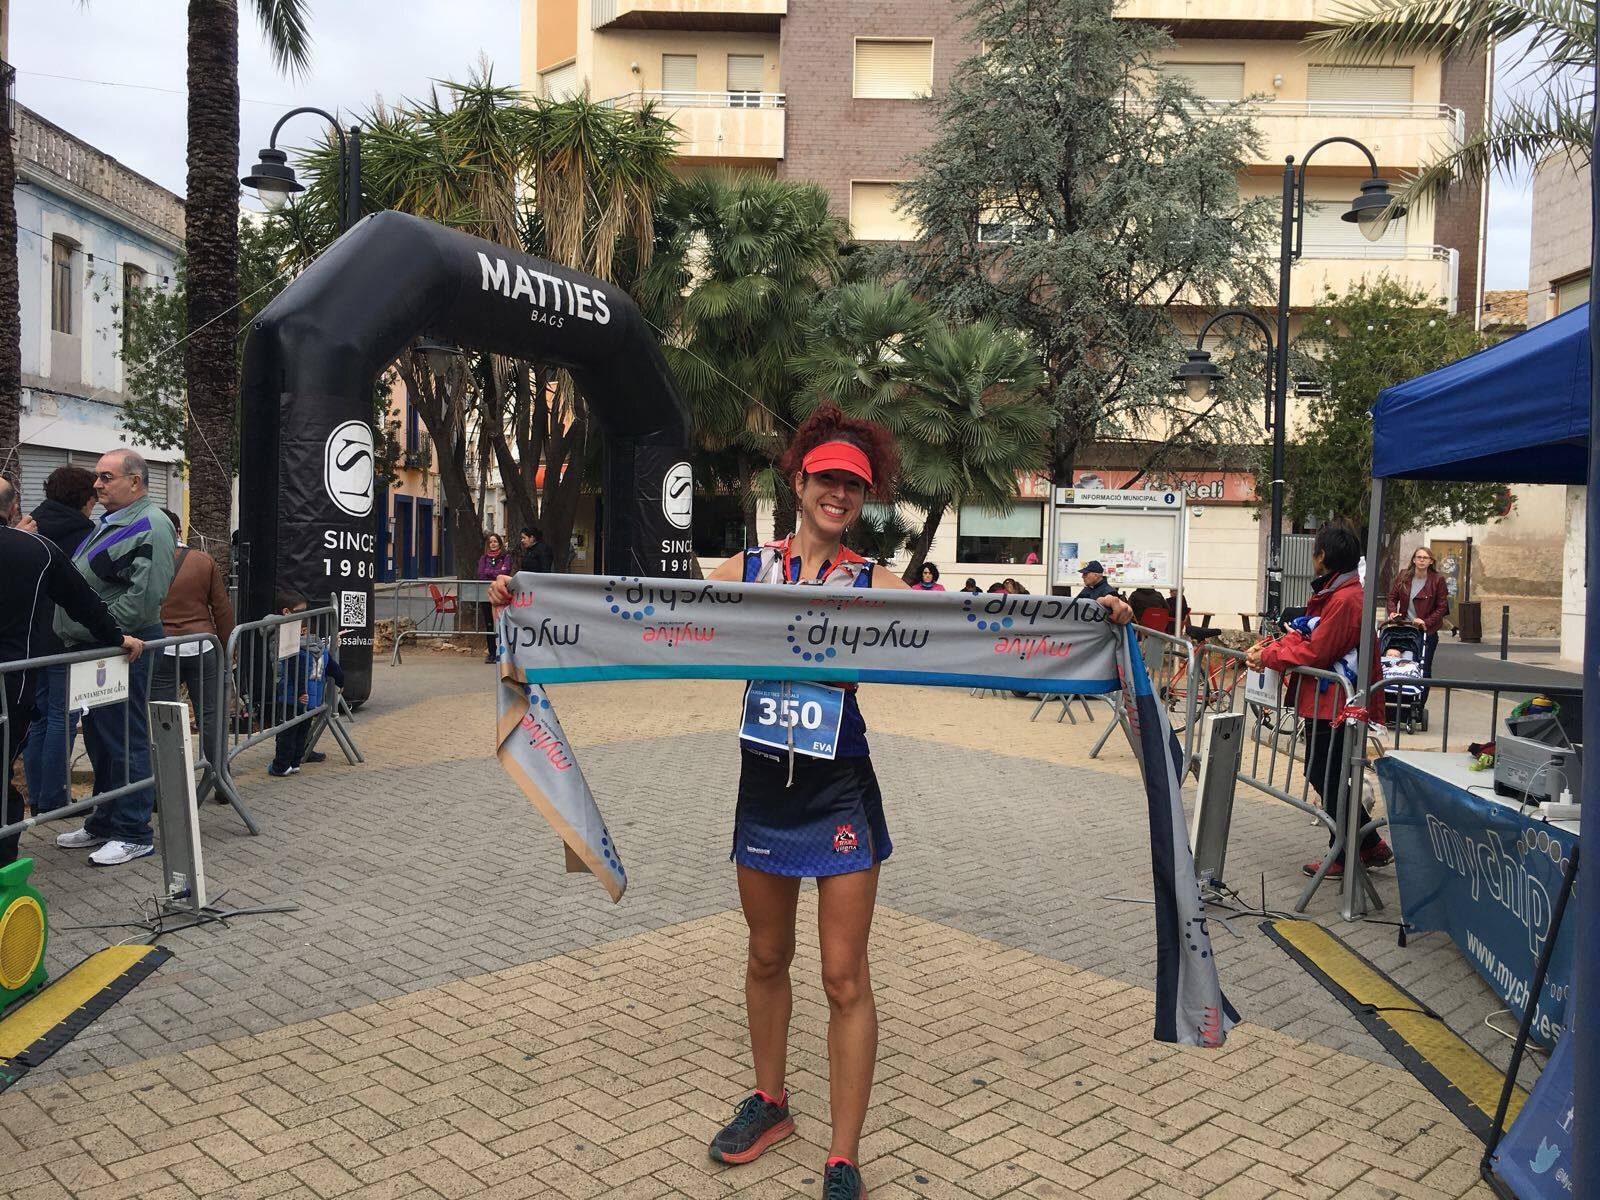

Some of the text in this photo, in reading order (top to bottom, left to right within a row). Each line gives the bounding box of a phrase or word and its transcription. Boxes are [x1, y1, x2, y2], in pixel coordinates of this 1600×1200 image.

[477, 252, 611, 325] MATTIES
[530, 309, 565, 329] BAGS
[1081, 493, 1121, 501] INFORMACIÓ
[323, 529, 374, 553] SINCE
[323, 558, 374, 579] 1980
[626, 582, 744, 611] mychip
[504, 617, 580, 655] mych
[642, 622, 715, 648] mylive
[807, 617, 930, 654] mychip
[993, 634, 1073, 661] mylive
[758, 697, 822, 729] 350
[812, 741, 832, 753] EVA
[1425, 813, 1552, 958] mychip
